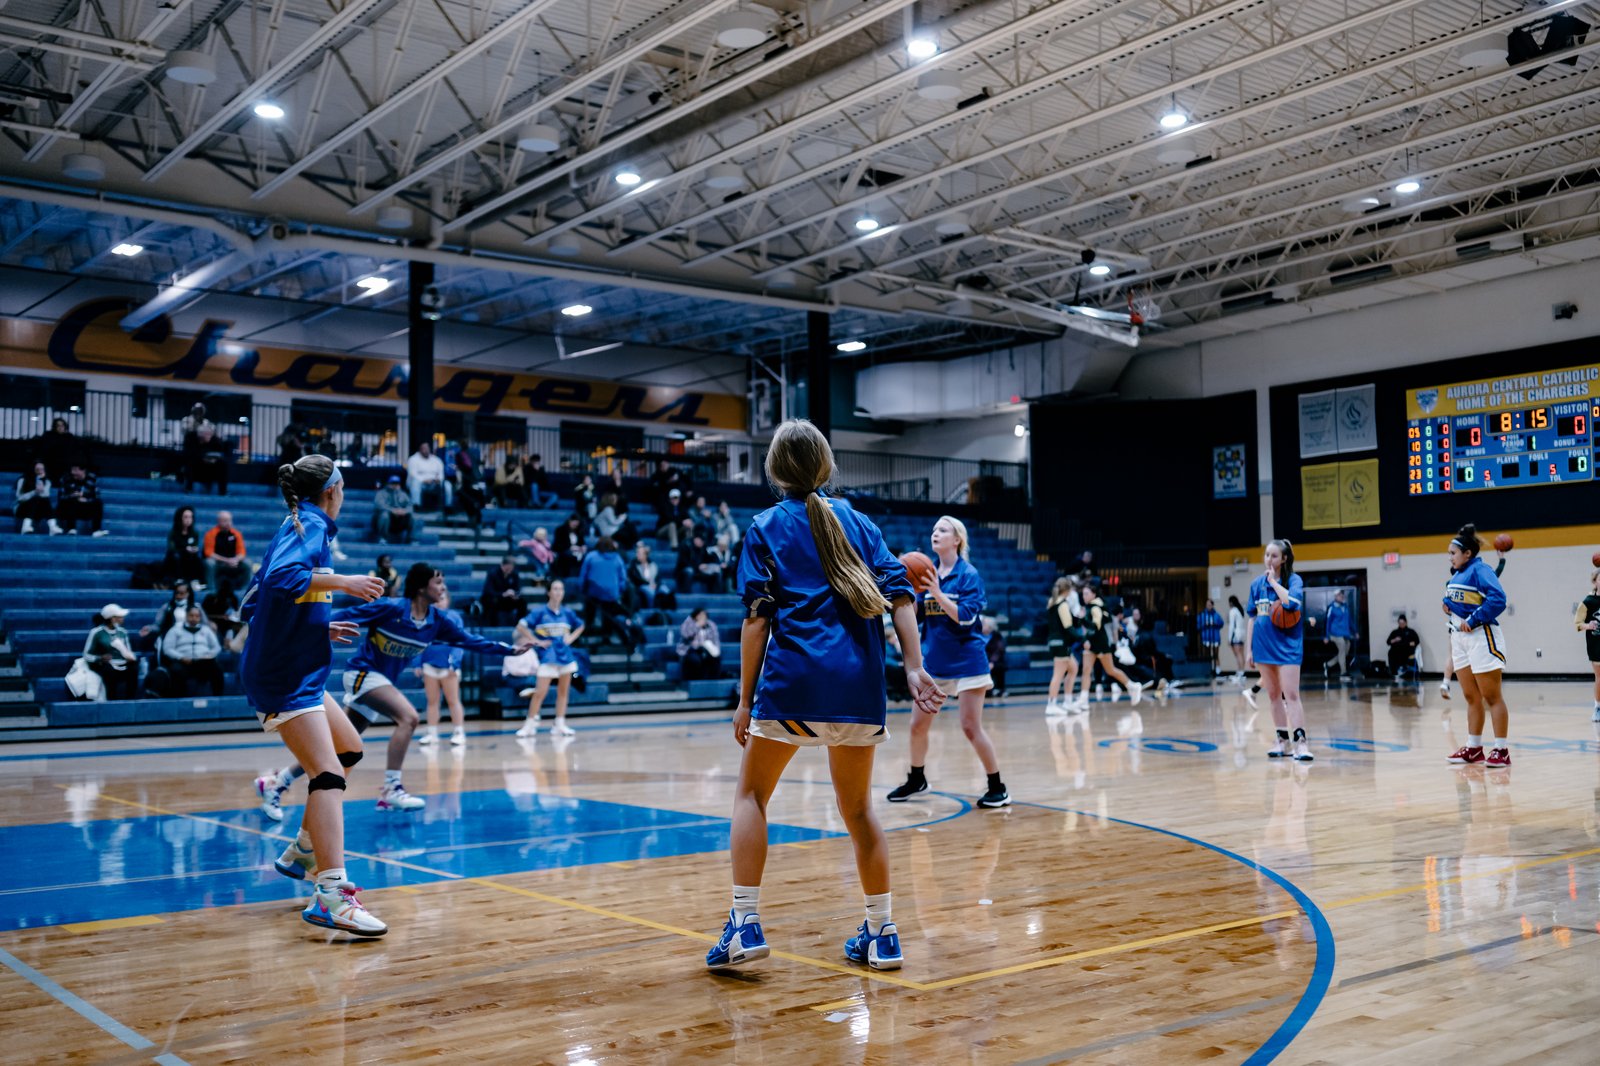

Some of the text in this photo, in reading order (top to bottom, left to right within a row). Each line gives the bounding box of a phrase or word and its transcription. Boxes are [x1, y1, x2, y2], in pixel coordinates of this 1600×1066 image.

[1447, 382, 1490, 399] AURORA
[1492, 375, 1540, 393] CENTRAL
[1542, 367, 1598, 386] CATHOLIC
[1456, 382, 1589, 411] HOME OF THE CHARGERS
[1554, 402, 1588, 415] VISITOR
[1456, 416, 1480, 427] HOME
[1574, 415, 1585, 435] 0
[1471, 427, 1481, 446] 0
[1553, 438, 1575, 447] BONUS
[1502, 439, 1524, 448] PERIOD
[1528, 452, 1548, 461] FOULS
[1568, 448, 1589, 457] FOULS
[1496, 455, 1519, 464] PLAYER
[1578, 456, 1587, 472] 0
[1464, 466, 1474, 483] 0
